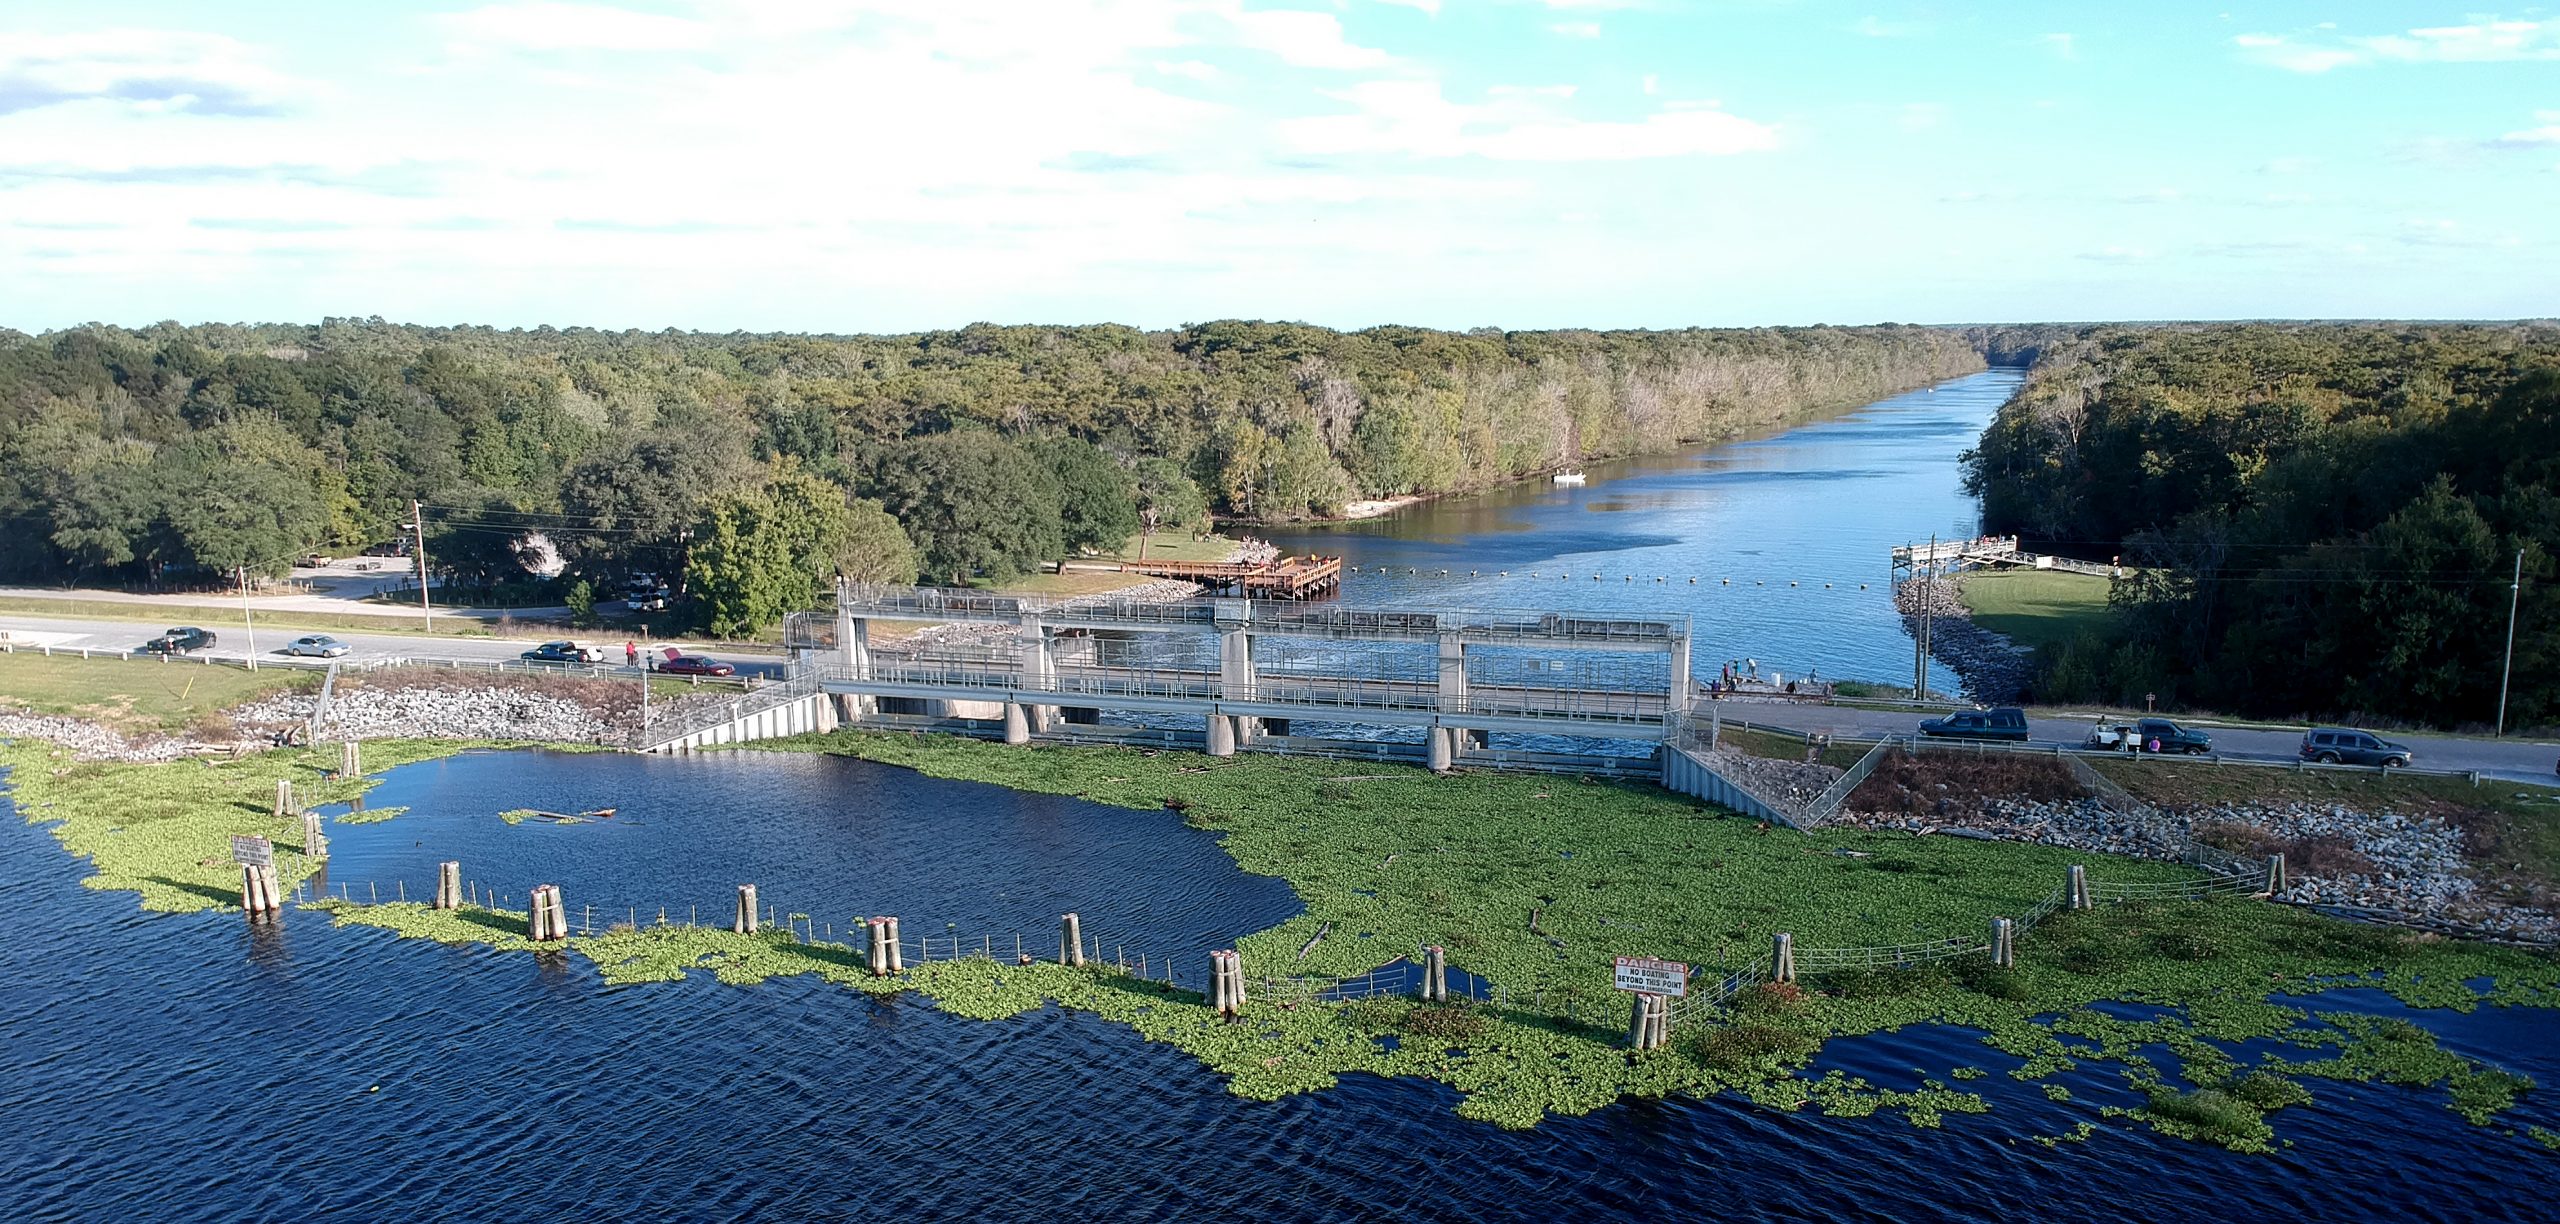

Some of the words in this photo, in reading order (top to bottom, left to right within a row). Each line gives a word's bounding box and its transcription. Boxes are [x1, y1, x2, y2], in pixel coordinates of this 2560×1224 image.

[1617, 957, 1683, 972] DANGER
[1642, 970, 1670, 979] BOATING
[1617, 975, 1643, 984] BEYOND
[1646, 978, 1660, 986] THIS
[1663, 980, 1682, 989] POINT
